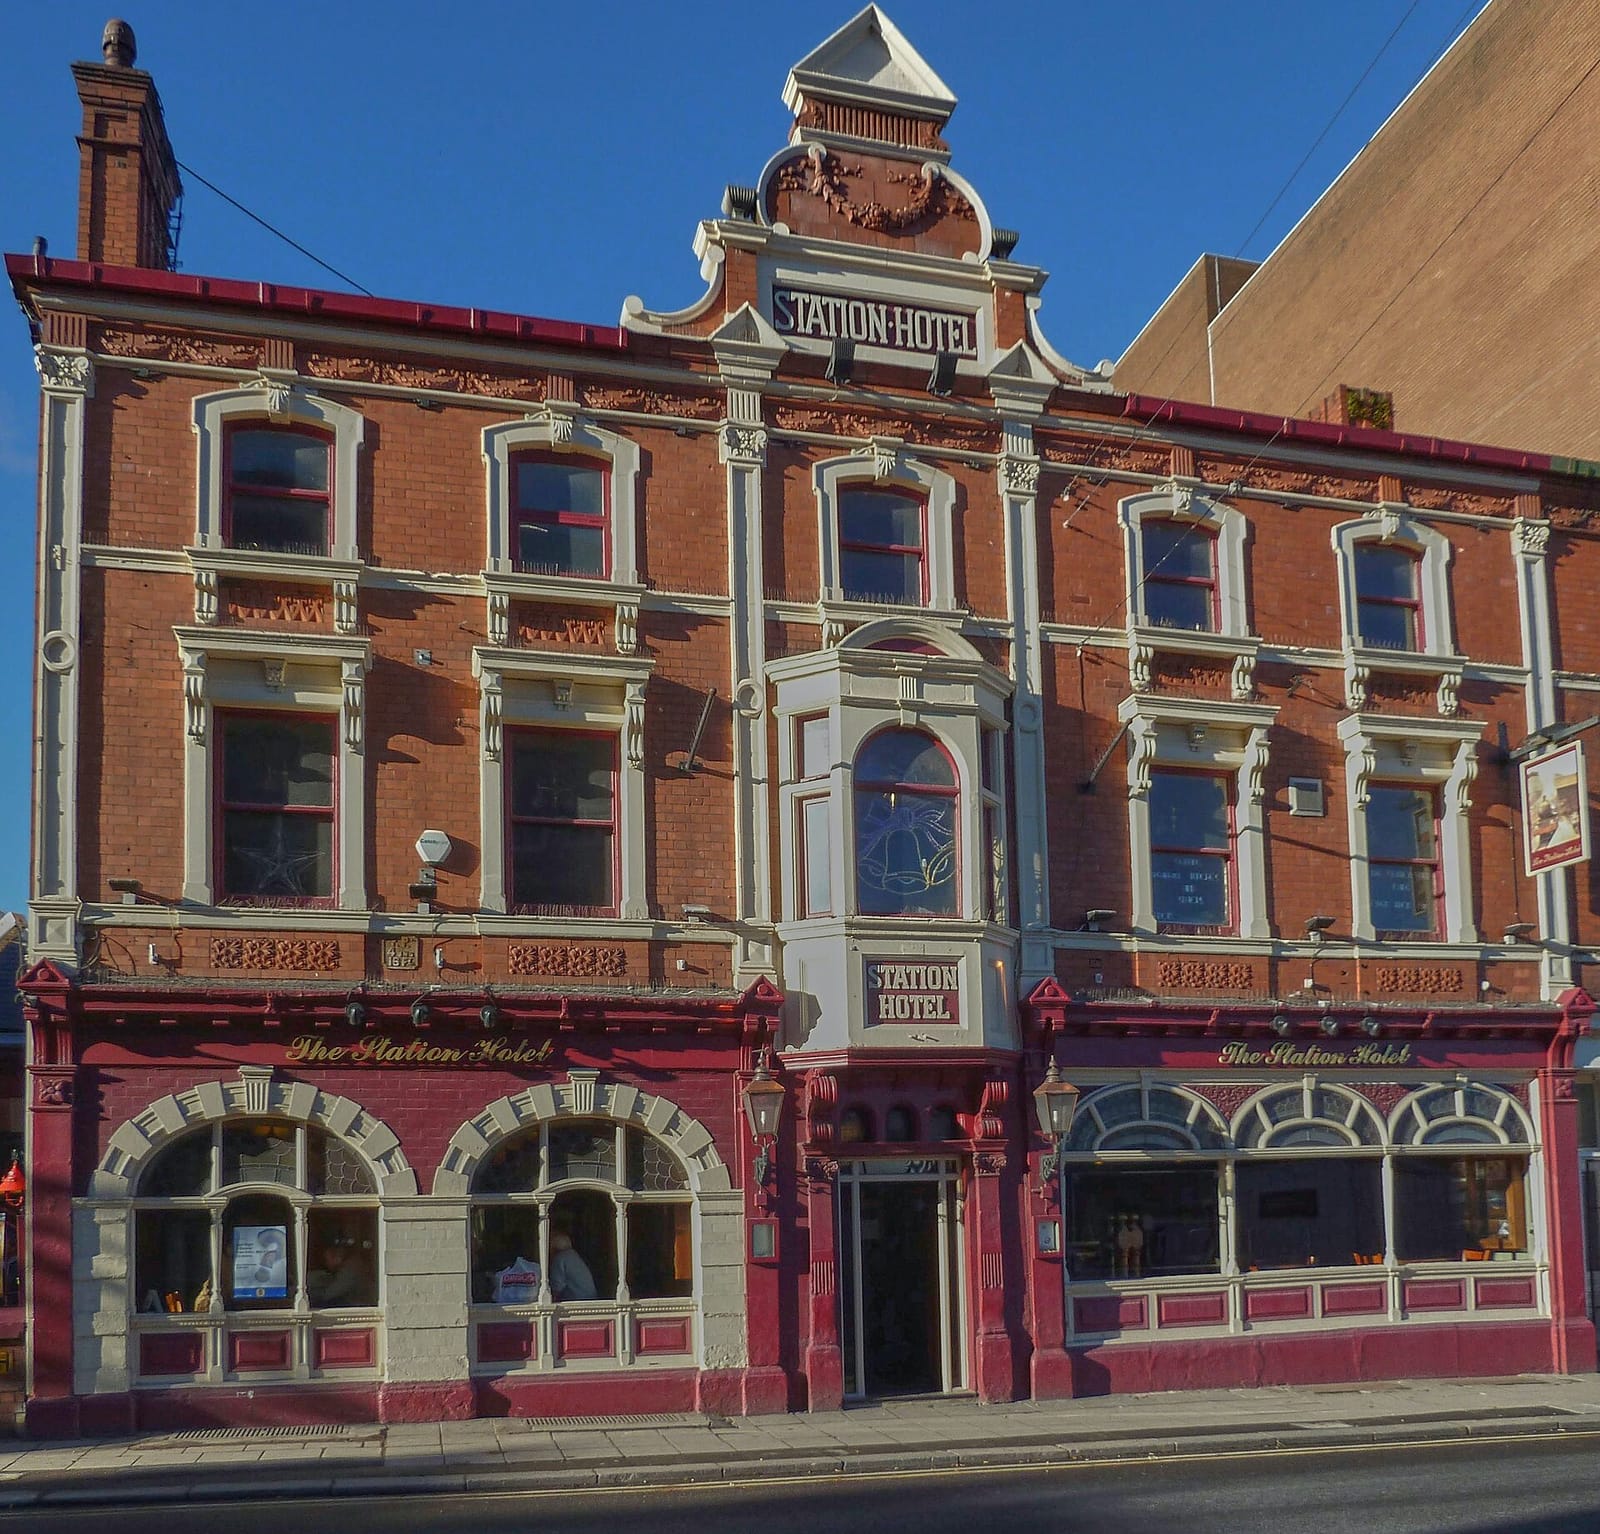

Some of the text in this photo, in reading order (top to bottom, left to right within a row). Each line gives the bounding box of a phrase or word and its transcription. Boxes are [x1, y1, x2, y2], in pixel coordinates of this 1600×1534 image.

[867, 964, 958, 991] STATION
[878, 994, 951, 1020] HOTEL
[285, 1034, 554, 1063] The Station Hotel
[1218, 1041, 1411, 1066] The Station Hotel
